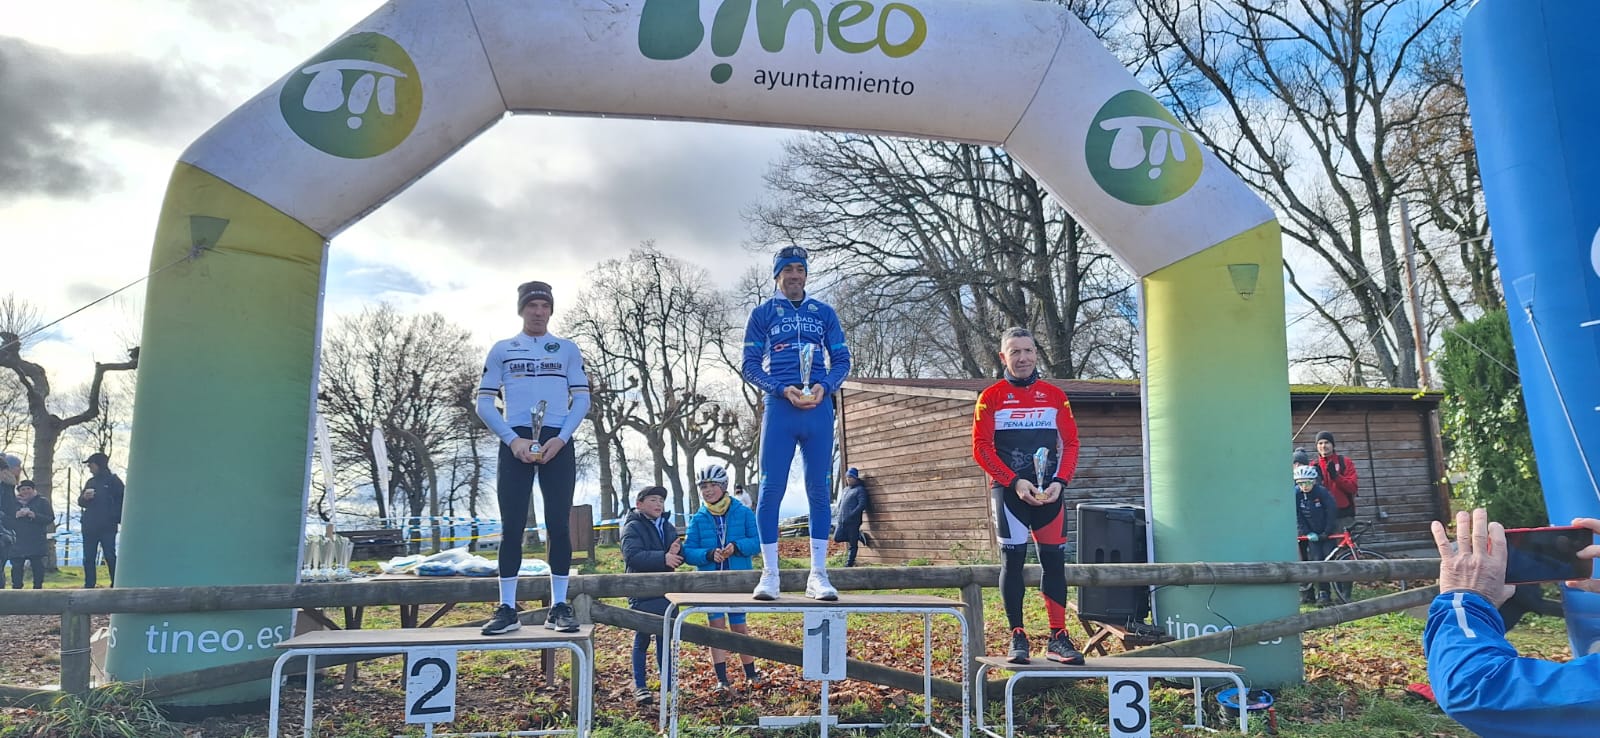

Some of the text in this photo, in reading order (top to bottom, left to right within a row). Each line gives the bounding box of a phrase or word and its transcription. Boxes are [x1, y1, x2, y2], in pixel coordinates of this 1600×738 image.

[753, 69, 914, 96] ayuntamiento
[782, 322, 824, 335] OVIEDO
[145, 621, 284, 654] tineo.es
[807, 619, 830, 675] 1
[410, 657, 451, 715] 2
[1112, 680, 1147, 734] 3
